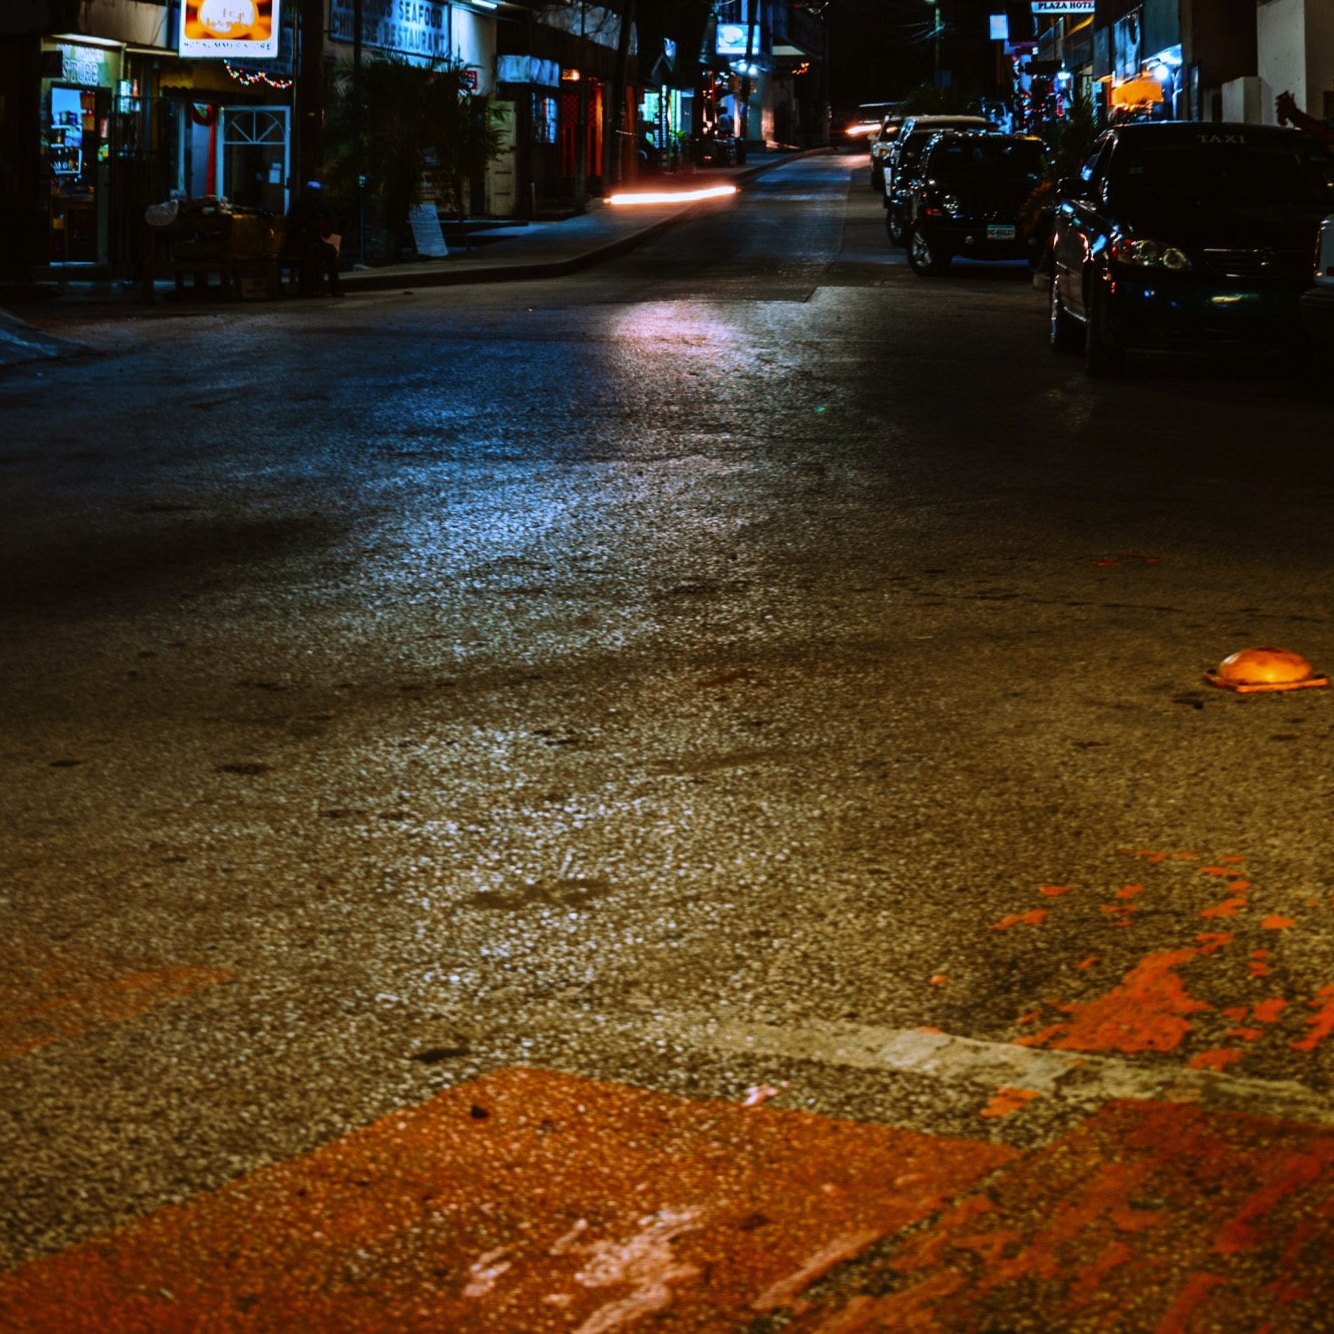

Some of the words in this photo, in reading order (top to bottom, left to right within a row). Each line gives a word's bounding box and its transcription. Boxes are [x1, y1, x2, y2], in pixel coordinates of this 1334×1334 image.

[398, 0, 443, 29] SEAFOOD
[1038, 2, 1067, 10] PLAZA
[332, 10, 378, 43] CHISE
[384, 21, 445, 55] RESTAURANT
[1196, 134, 1246, 144] TAXI
